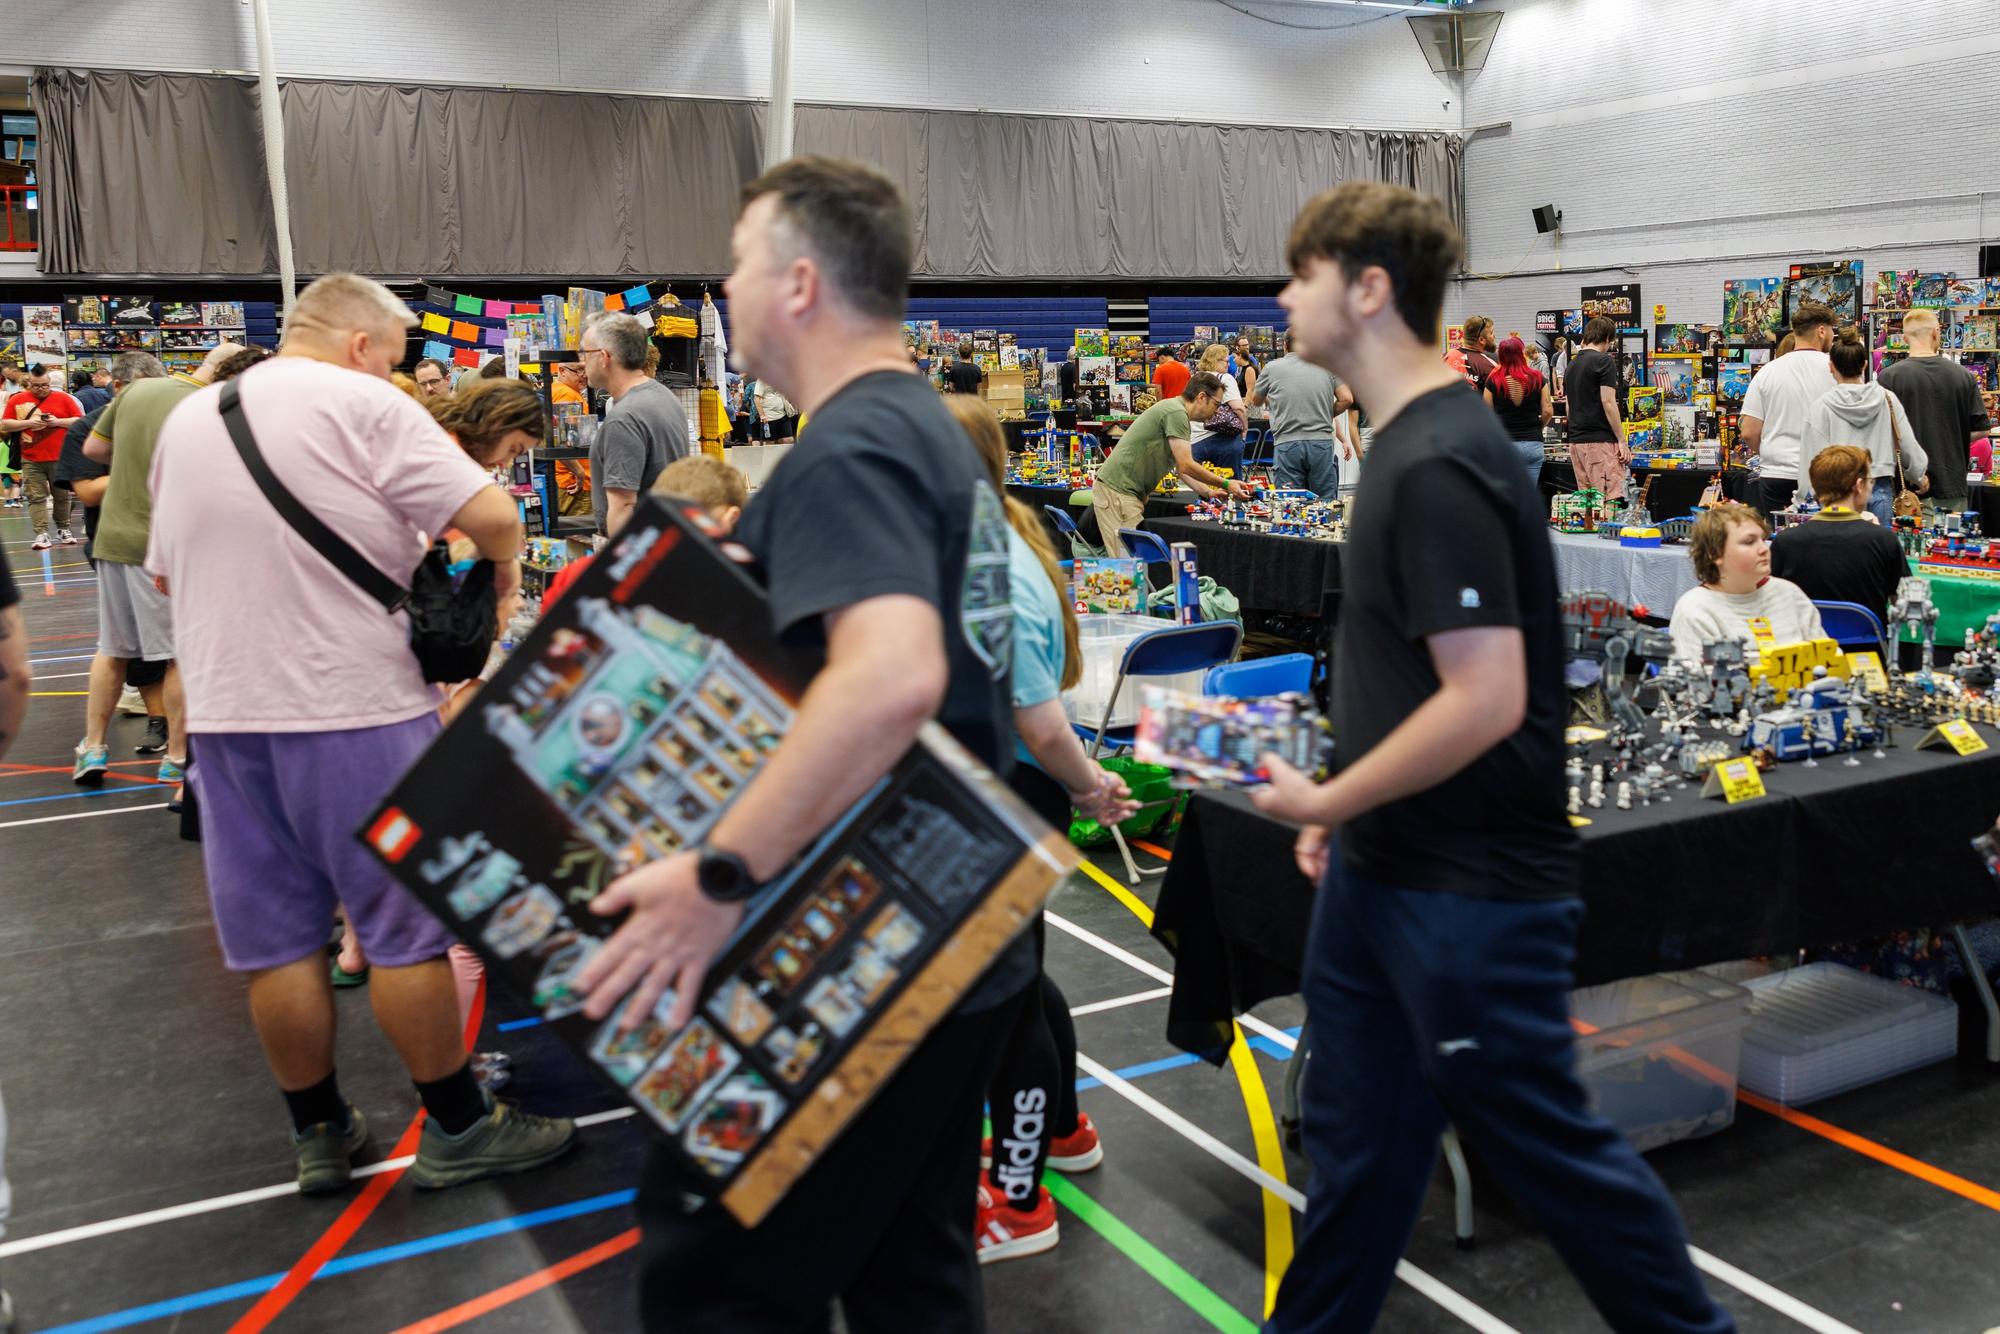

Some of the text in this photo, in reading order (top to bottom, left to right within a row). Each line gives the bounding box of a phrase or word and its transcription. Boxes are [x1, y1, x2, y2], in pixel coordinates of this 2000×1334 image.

[1537, 314, 1556, 323] BRICK
[1750, 638, 1851, 678] STAR
[998, 1087, 1047, 1200] adidas
